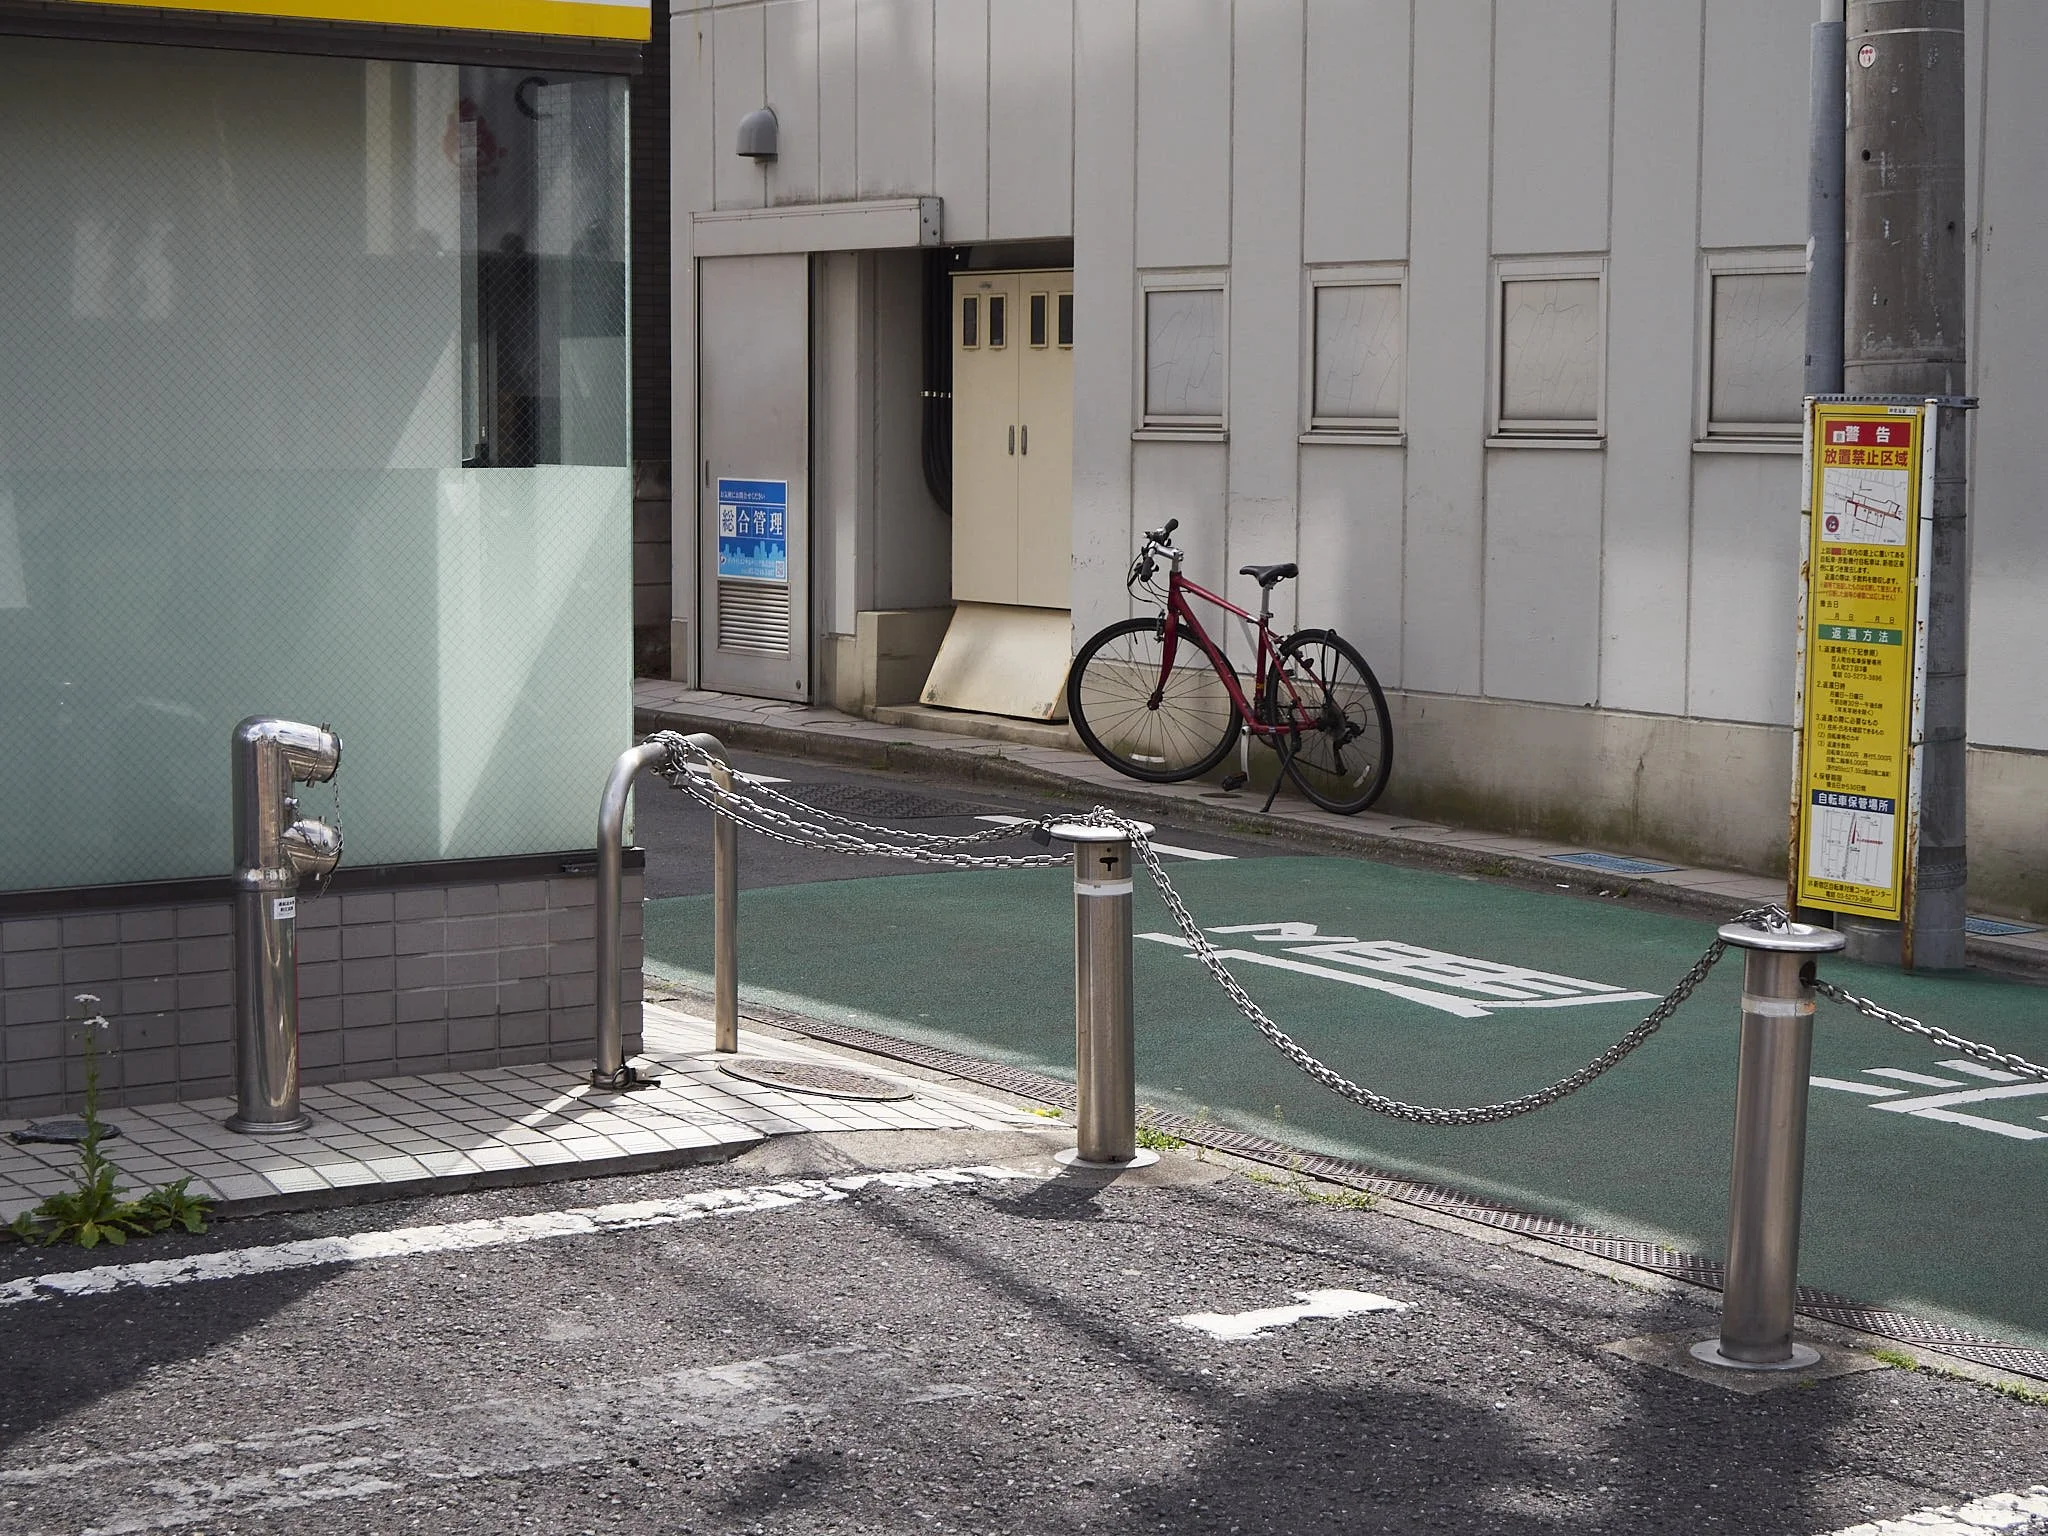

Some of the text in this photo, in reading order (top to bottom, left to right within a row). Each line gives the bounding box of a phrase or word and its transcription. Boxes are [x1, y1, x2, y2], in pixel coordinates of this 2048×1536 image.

[1845, 425, 1891, 443] 警告
[1824, 448, 1909, 467] 放置禁止区域
[722, 508, 783, 536] 総合管理
[1831, 627, 1888, 643] 返還方法
[1818, 793, 1889, 812] 自転車保管場所
